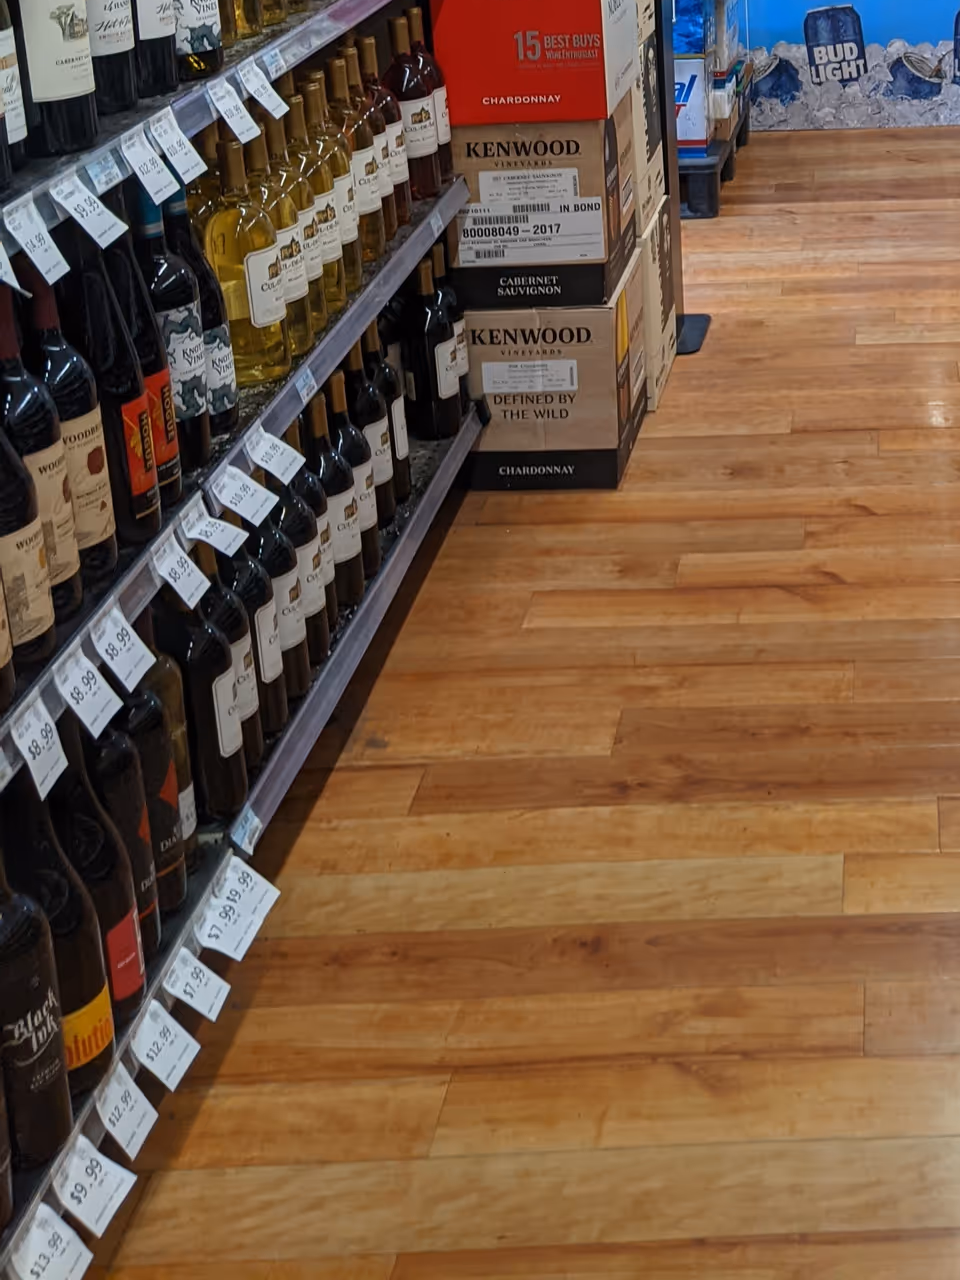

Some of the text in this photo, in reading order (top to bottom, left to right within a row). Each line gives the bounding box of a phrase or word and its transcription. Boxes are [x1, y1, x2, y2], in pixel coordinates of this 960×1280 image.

[513, 29, 601, 61] 15 BEST BUYS
[812, 43, 859, 63] BUD
[811, 59, 866, 83] LIGHT
[482, 93, 561, 106] CHARDONNAY
[466, 139, 581, 159] KENWOOD
[494, 159, 553, 168] VINEYARDS
[72, 195, 100, 220] $9.99
[560, 202, 601, 213] IN BOND
[463, 226, 519, 238] 80008049
[533, 223, 561, 234] 2017
[497, 285, 562, 297] SAUVIGNON
[499, 275, 558, 287] CABERNET
[470, 326, 592, 346] KENWOOD
[500, 347, 562, 357] VINEYARDS
[161, 386, 175, 442] HOGUE
[493, 393, 577, 406] DEFINED BY
[502, 408, 569, 420] THE WILD
[140, 413, 153, 472] HOGUE
[499, 465, 575, 476] CHARDONNAY
[169, 555, 191, 584] $8.99
[105, 626, 132, 662] $8.99
[70, 669, 99, 706] $8.99
[27, 721, 55, 762] $8.99
[226, 870, 255, 908] $9.99
[206, 904, 237, 941] $7.99
[182, 965, 207, 1001] $7.99
[13, 986, 59, 1040] Black
[31, 1014, 59, 1054] Ink
[145, 1024, 174, 1064] $12.99
[107, 1087, 134, 1129] $12.99
[69, 1157, 105, 1206] $9.99
[30, 1232, 65, 1280] $13.99
